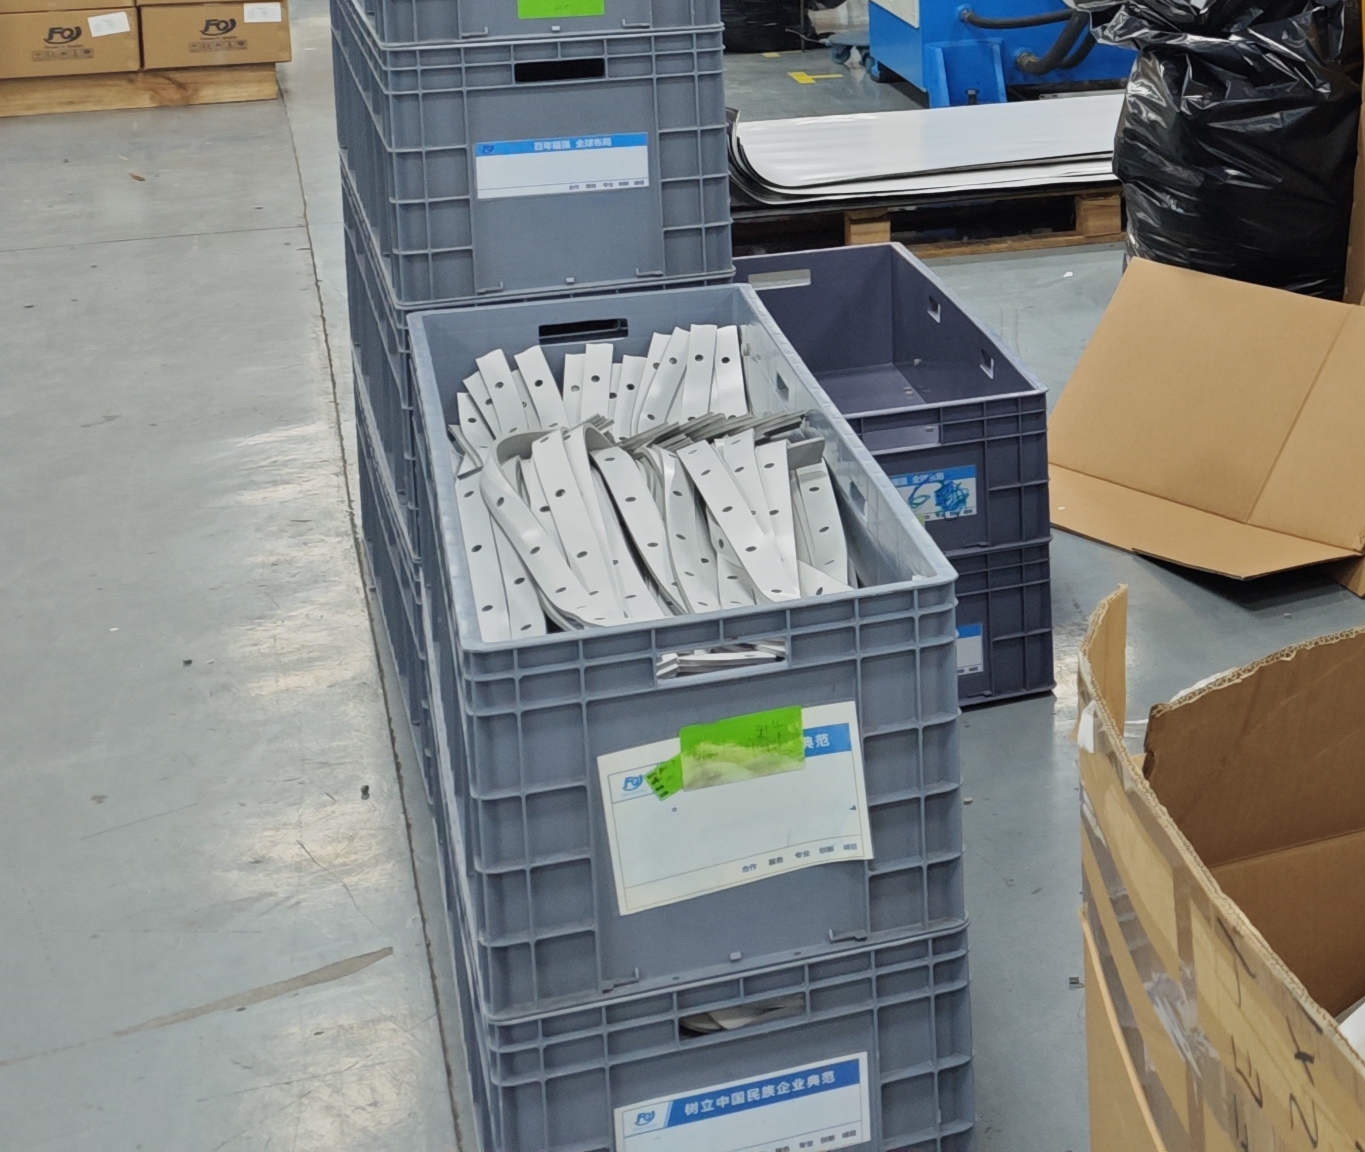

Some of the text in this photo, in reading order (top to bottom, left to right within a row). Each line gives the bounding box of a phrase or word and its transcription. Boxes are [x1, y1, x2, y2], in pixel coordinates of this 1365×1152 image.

[46, 26, 79, 43] FQ
[202, 18, 233, 35] FQ
[684, 1070, 836, 1116] 树立中国民族企业典范
